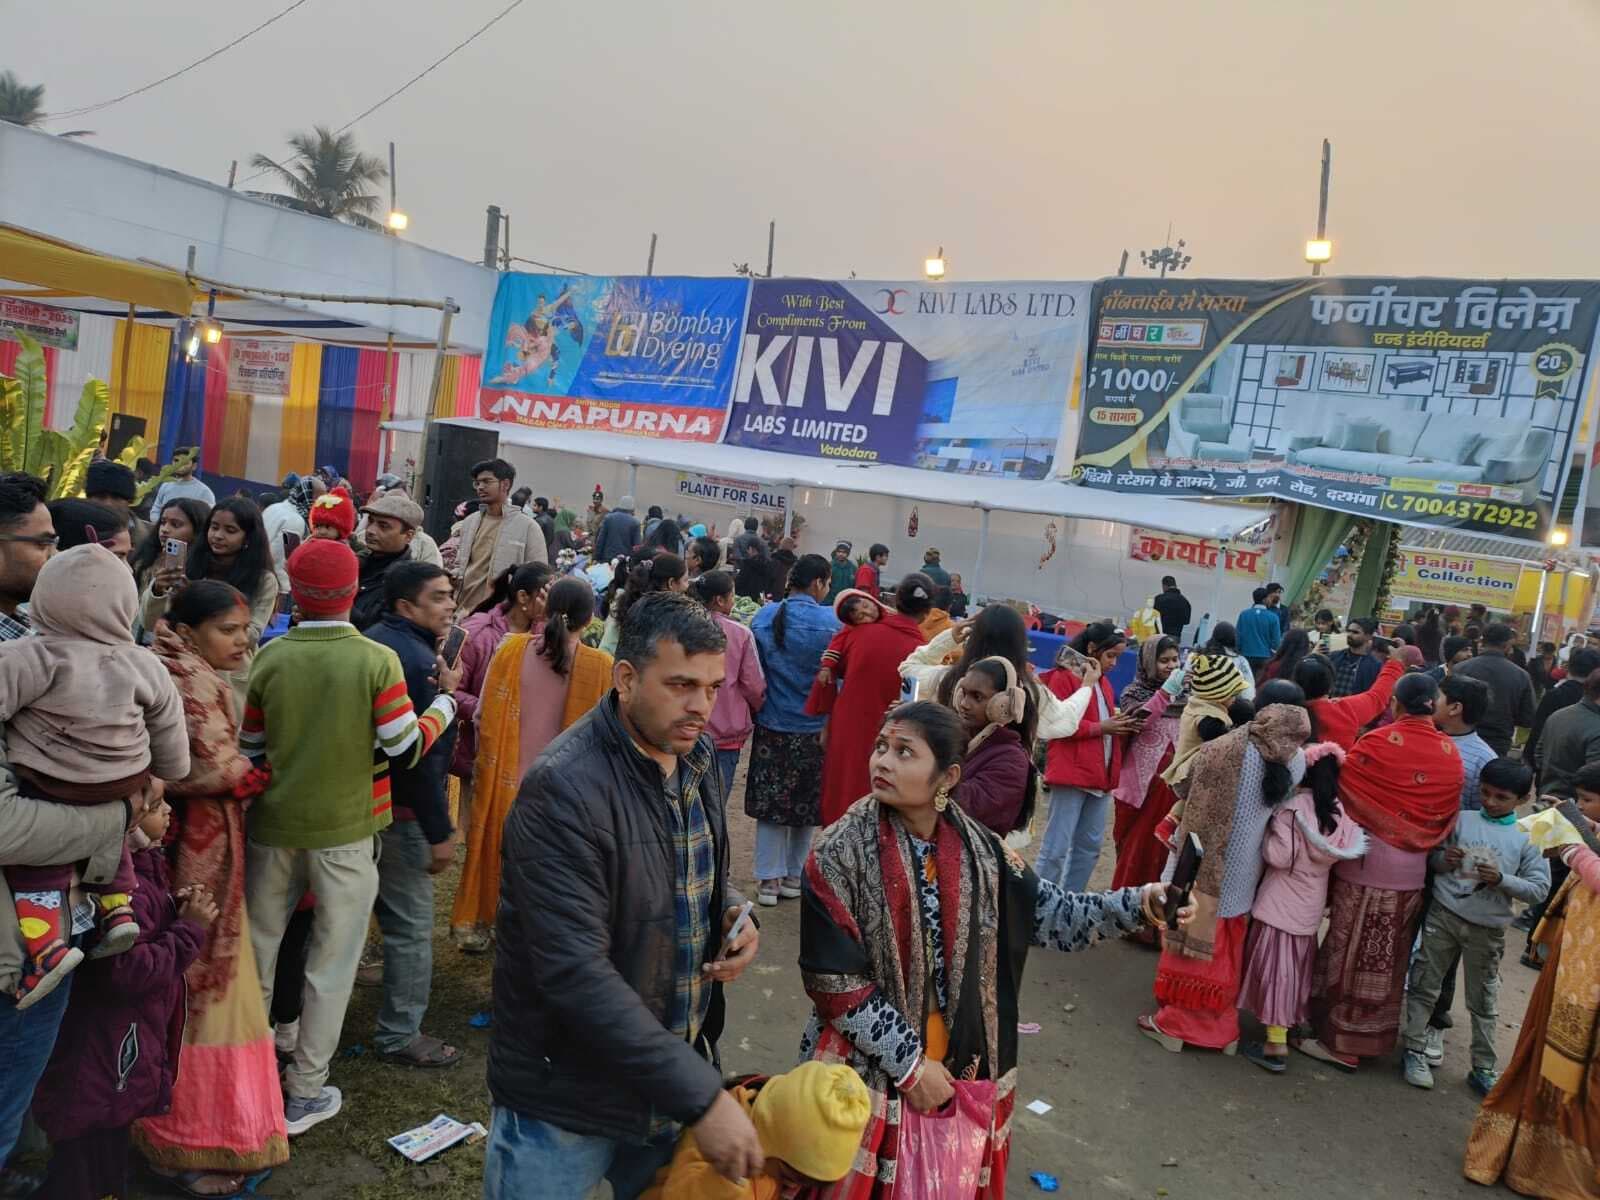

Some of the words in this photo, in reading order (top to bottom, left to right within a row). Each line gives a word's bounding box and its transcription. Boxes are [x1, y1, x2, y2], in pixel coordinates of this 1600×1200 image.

[782, 294, 812, 309] With
[816, 295, 845, 312] Best
[917, 292, 957, 314] KIVI
[964, 293, 1018, 316] LABS
[1025, 293, 1077, 317] LTD.
[1310, 286, 1449, 328] फर्नीचर
[1455, 287, 1580, 334] विलेज़
[649, 309, 738, 341] Bombay
[757, 312, 825, 330] Compliments
[827, 315, 866, 332] From
[641, 336, 722, 369] Dyeing
[1538, 355, 1561, 369] 20
[735, 334, 904, 416] KIVI
[489, 395, 712, 436] ANNAPURNA
[743, 414, 787, 435] LABS
[792, 418, 868, 444] LIMITED
[820, 443, 878, 460] Vadodara
[680, 480, 720, 498] PLANT
[722, 487, 748, 503] FOR
[750, 492, 786, 509] SALE
[1402, 495, 1538, 530] 7004372922
[1140, 535, 1262, 573] कार्यालय
[1414, 555, 1474, 573] Balaji
[1418, 568, 1513, 590] Collection
